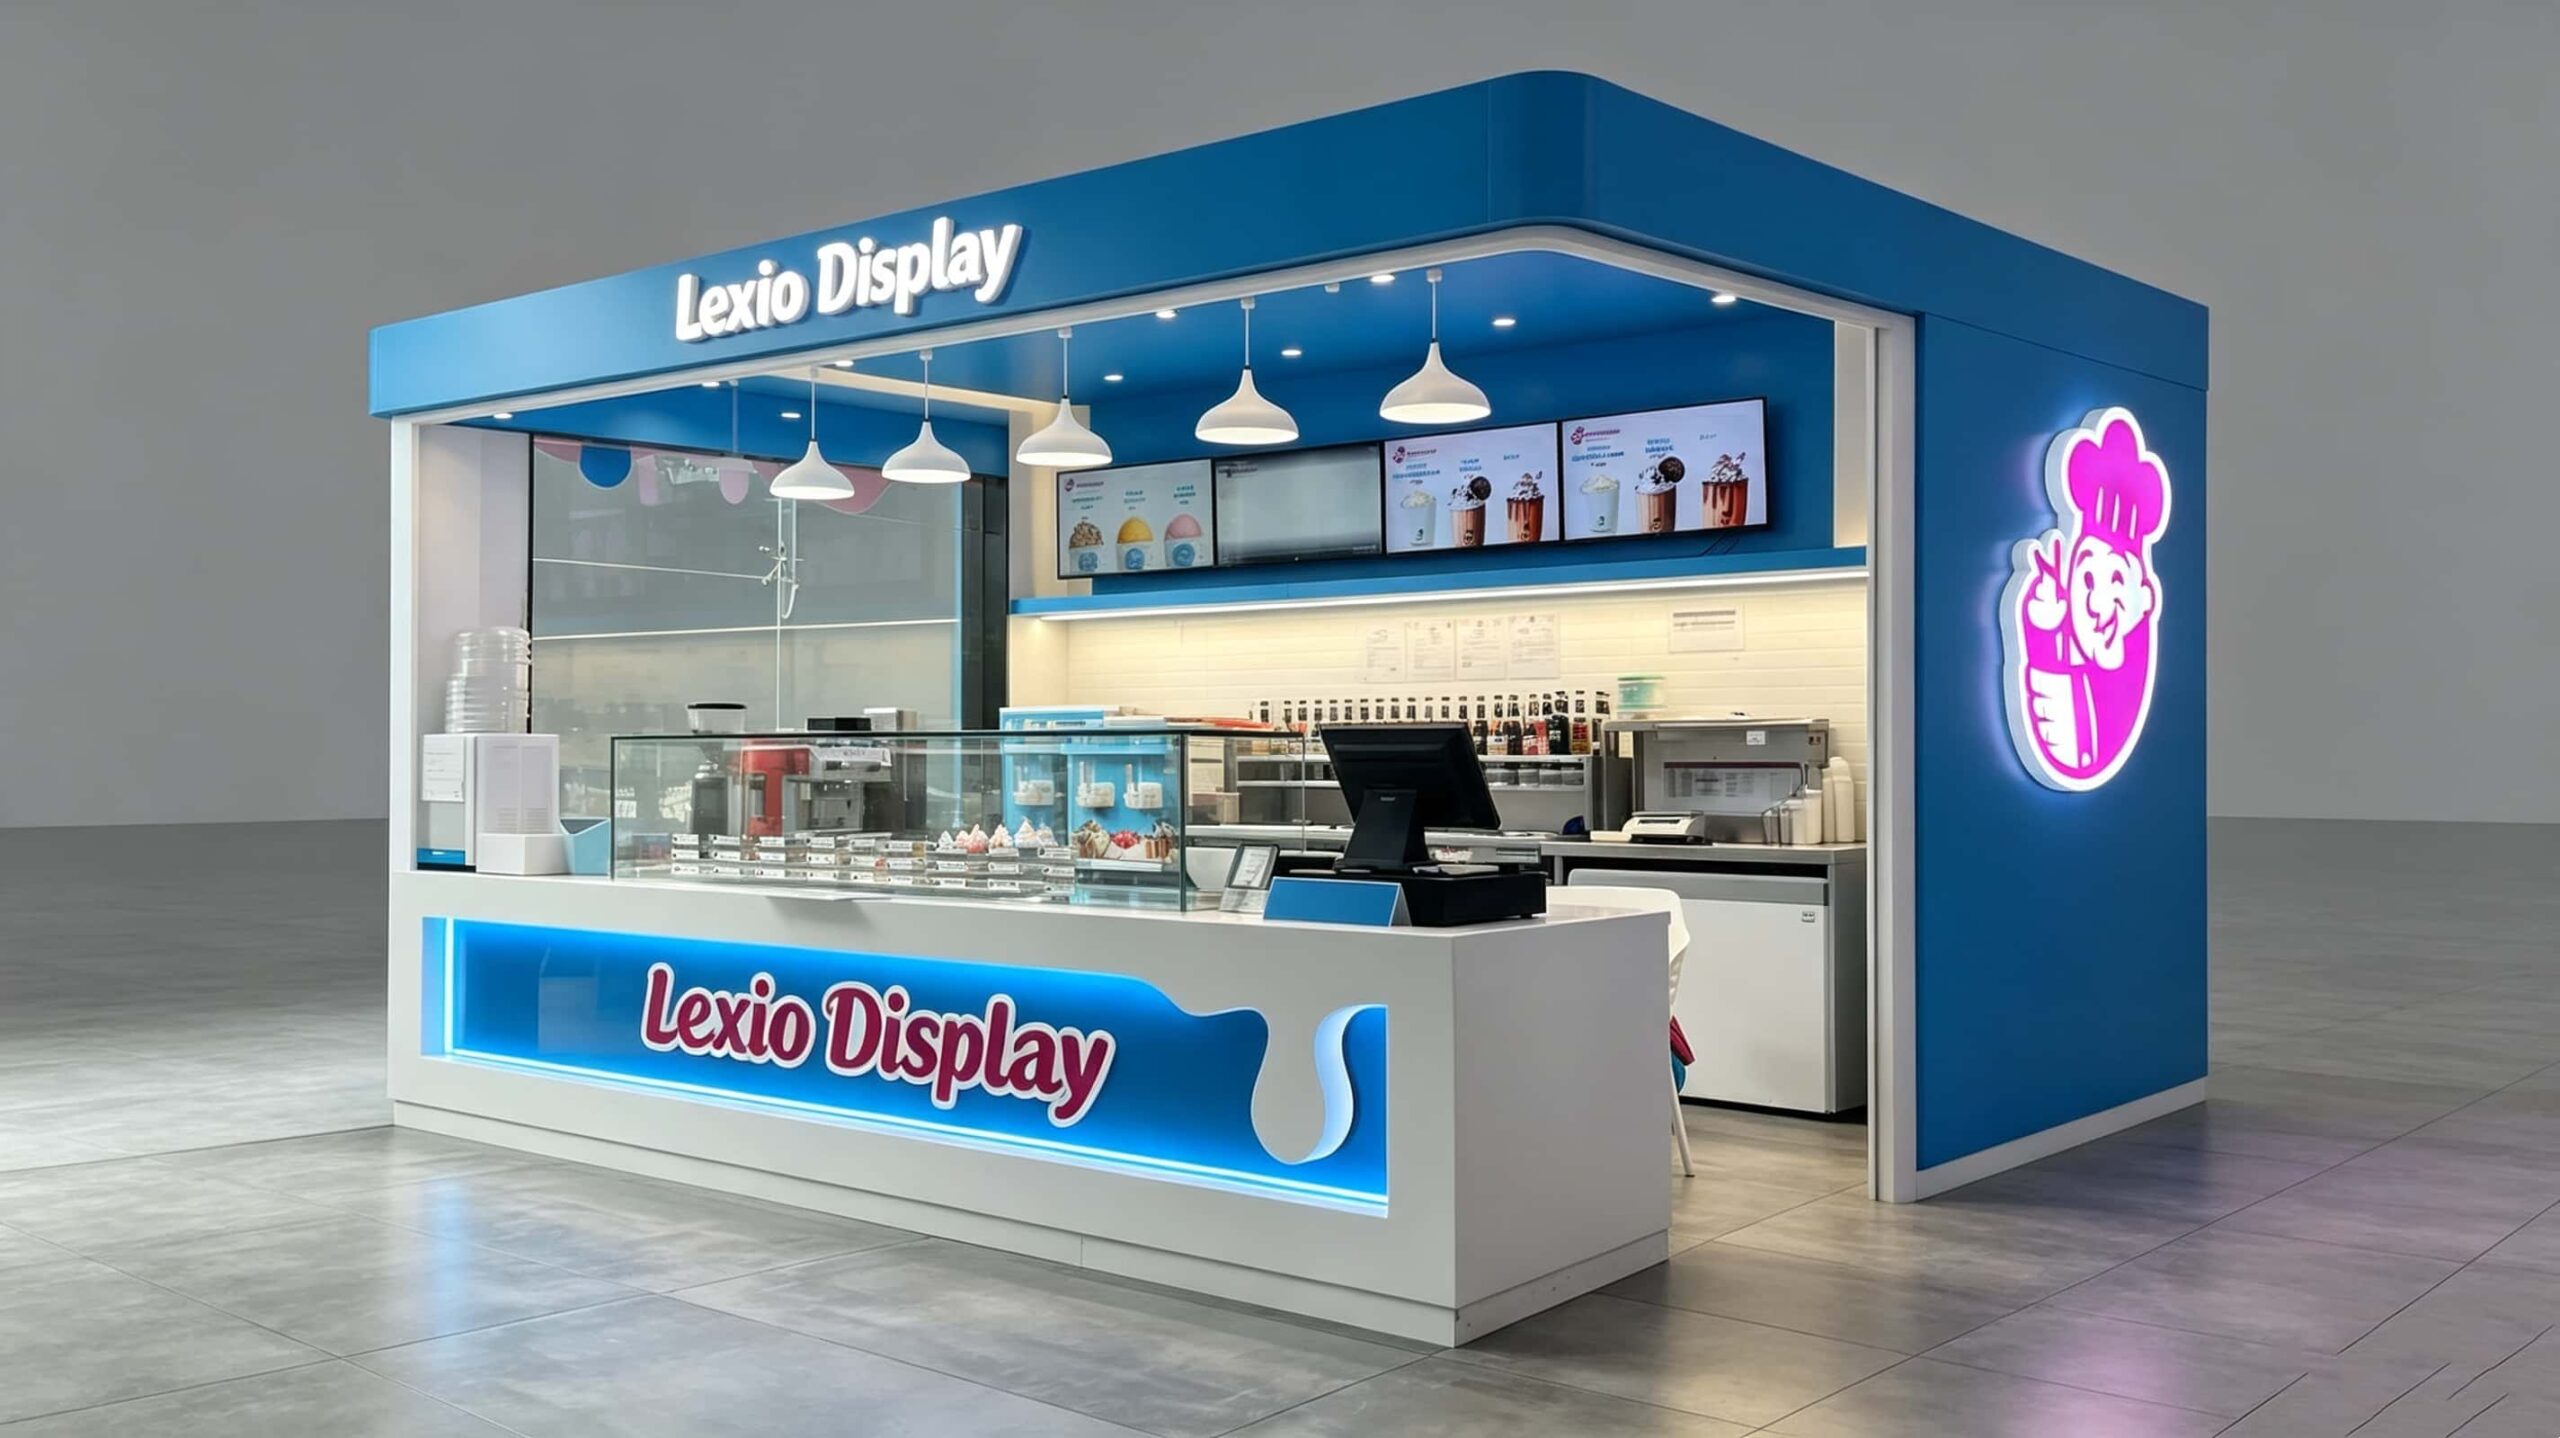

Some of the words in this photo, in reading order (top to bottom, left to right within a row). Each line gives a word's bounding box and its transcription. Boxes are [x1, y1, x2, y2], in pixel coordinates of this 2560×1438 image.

[675, 260, 809, 342] Lexio
[817, 216, 1023, 315] Display
[643, 965, 813, 1064] Lexio
[824, 984, 1111, 1123] Display
